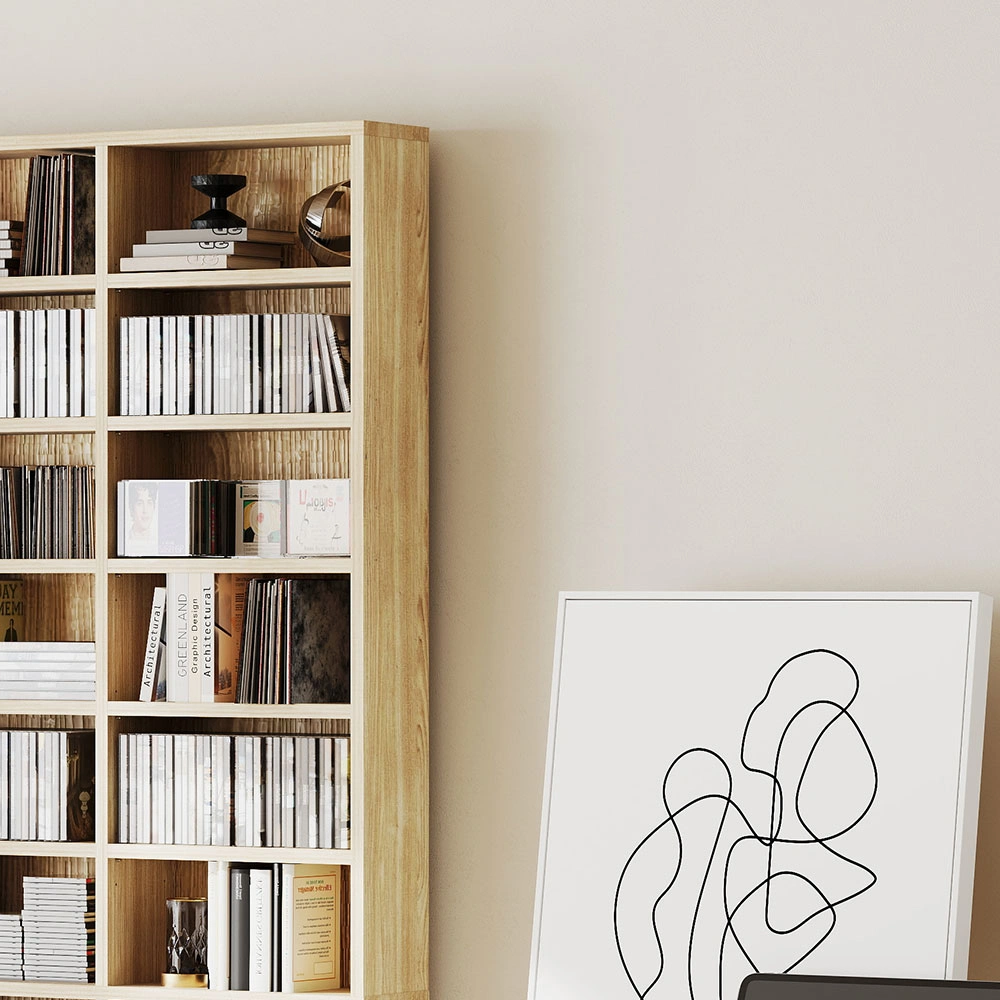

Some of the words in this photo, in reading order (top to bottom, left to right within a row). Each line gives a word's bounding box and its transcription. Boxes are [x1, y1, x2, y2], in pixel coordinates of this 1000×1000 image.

[144, 605, 161, 687] Architectural
[178, 593, 188, 678] GREENLAND
[191, 598, 199, 632] Design
[191, 635, 199, 674] Graphic
[203, 587, 211, 677] Architectural
